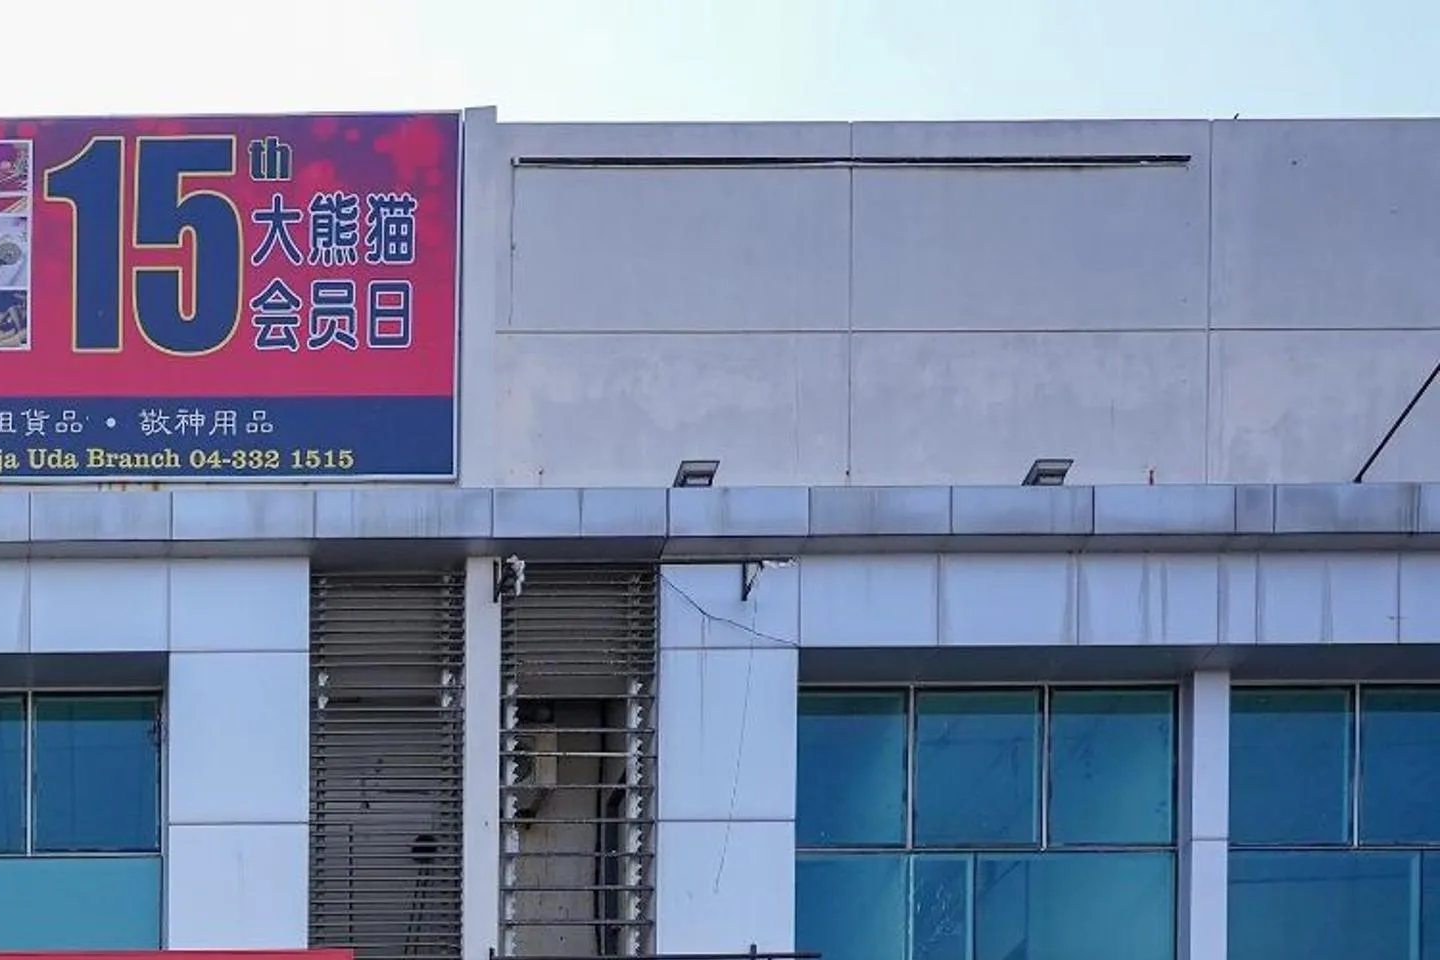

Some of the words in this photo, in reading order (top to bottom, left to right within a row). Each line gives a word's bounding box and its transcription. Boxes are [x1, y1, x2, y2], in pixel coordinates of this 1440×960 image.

[250, 192, 417, 266] 大熊猫
[251, 278, 413, 352] 会员日
[138, 407, 275, 436] 敬神用品
[27, 448, 80, 469] Uda
[85, 448, 181, 469] Branch
[188, 449, 281, 469] 04-332
[291, 449, 355, 469] 1515
